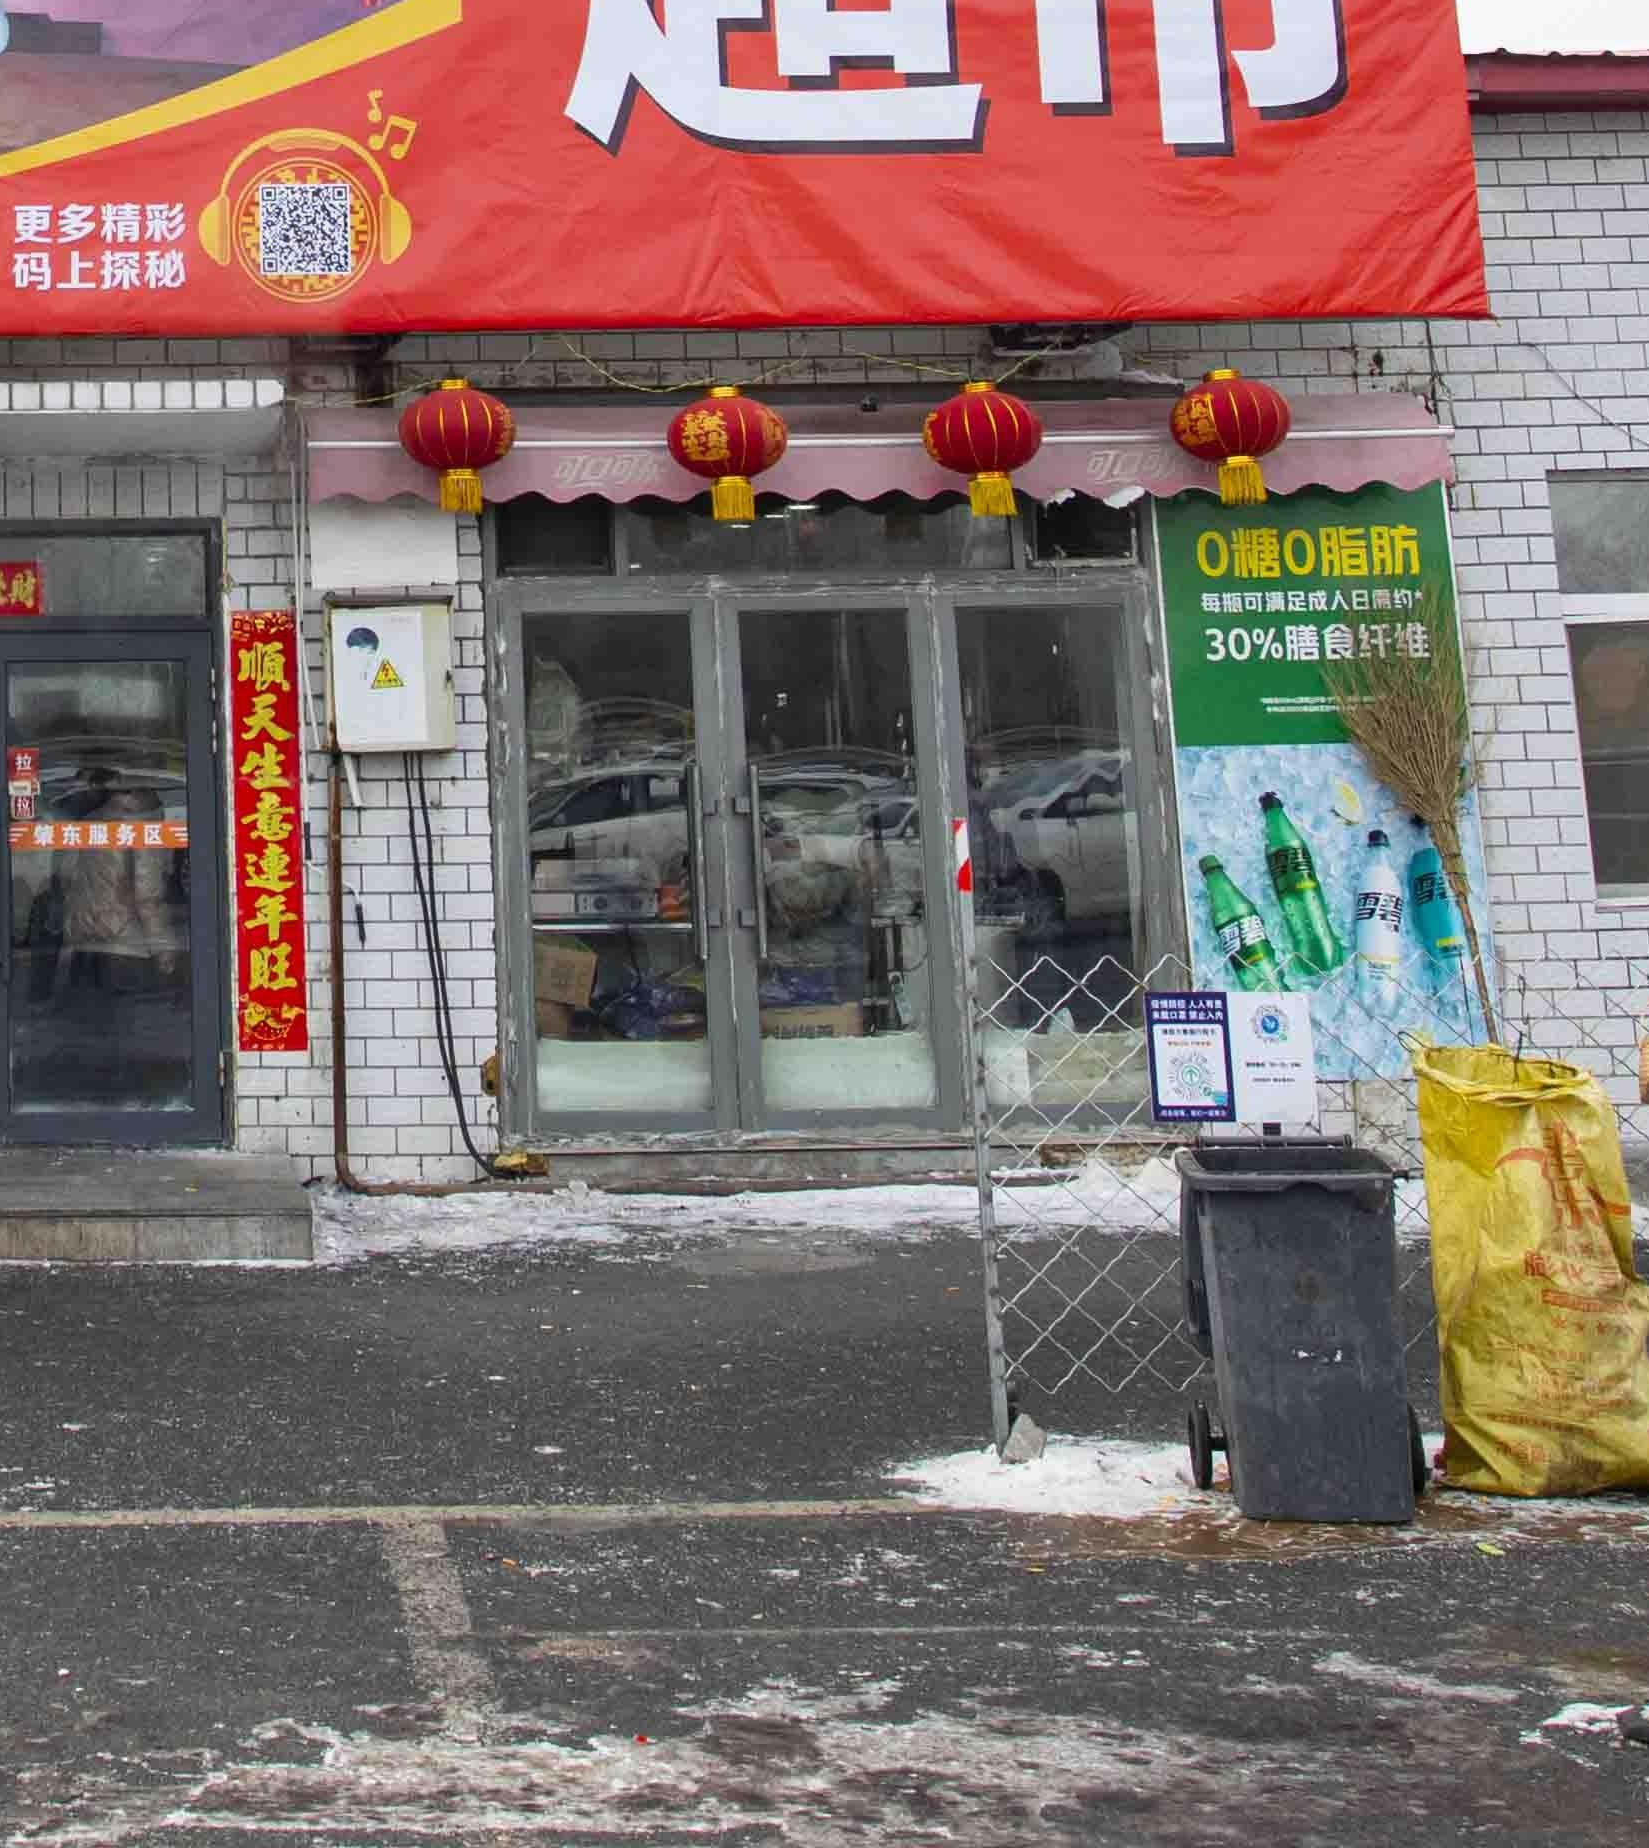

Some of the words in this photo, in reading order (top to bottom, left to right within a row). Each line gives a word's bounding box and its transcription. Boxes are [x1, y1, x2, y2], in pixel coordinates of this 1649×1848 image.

[13, 202, 187, 244] 更多精彩
[12, 250, 187, 291] 码上探秘
[1197, 525, 1421, 579] 0糖0脂肪
[1205, 622, 1432, 663] 30%膳食纤维
[33, 823, 164, 845] 肇东服务区
[237, 640, 299, 992] 順天生意連年旺
